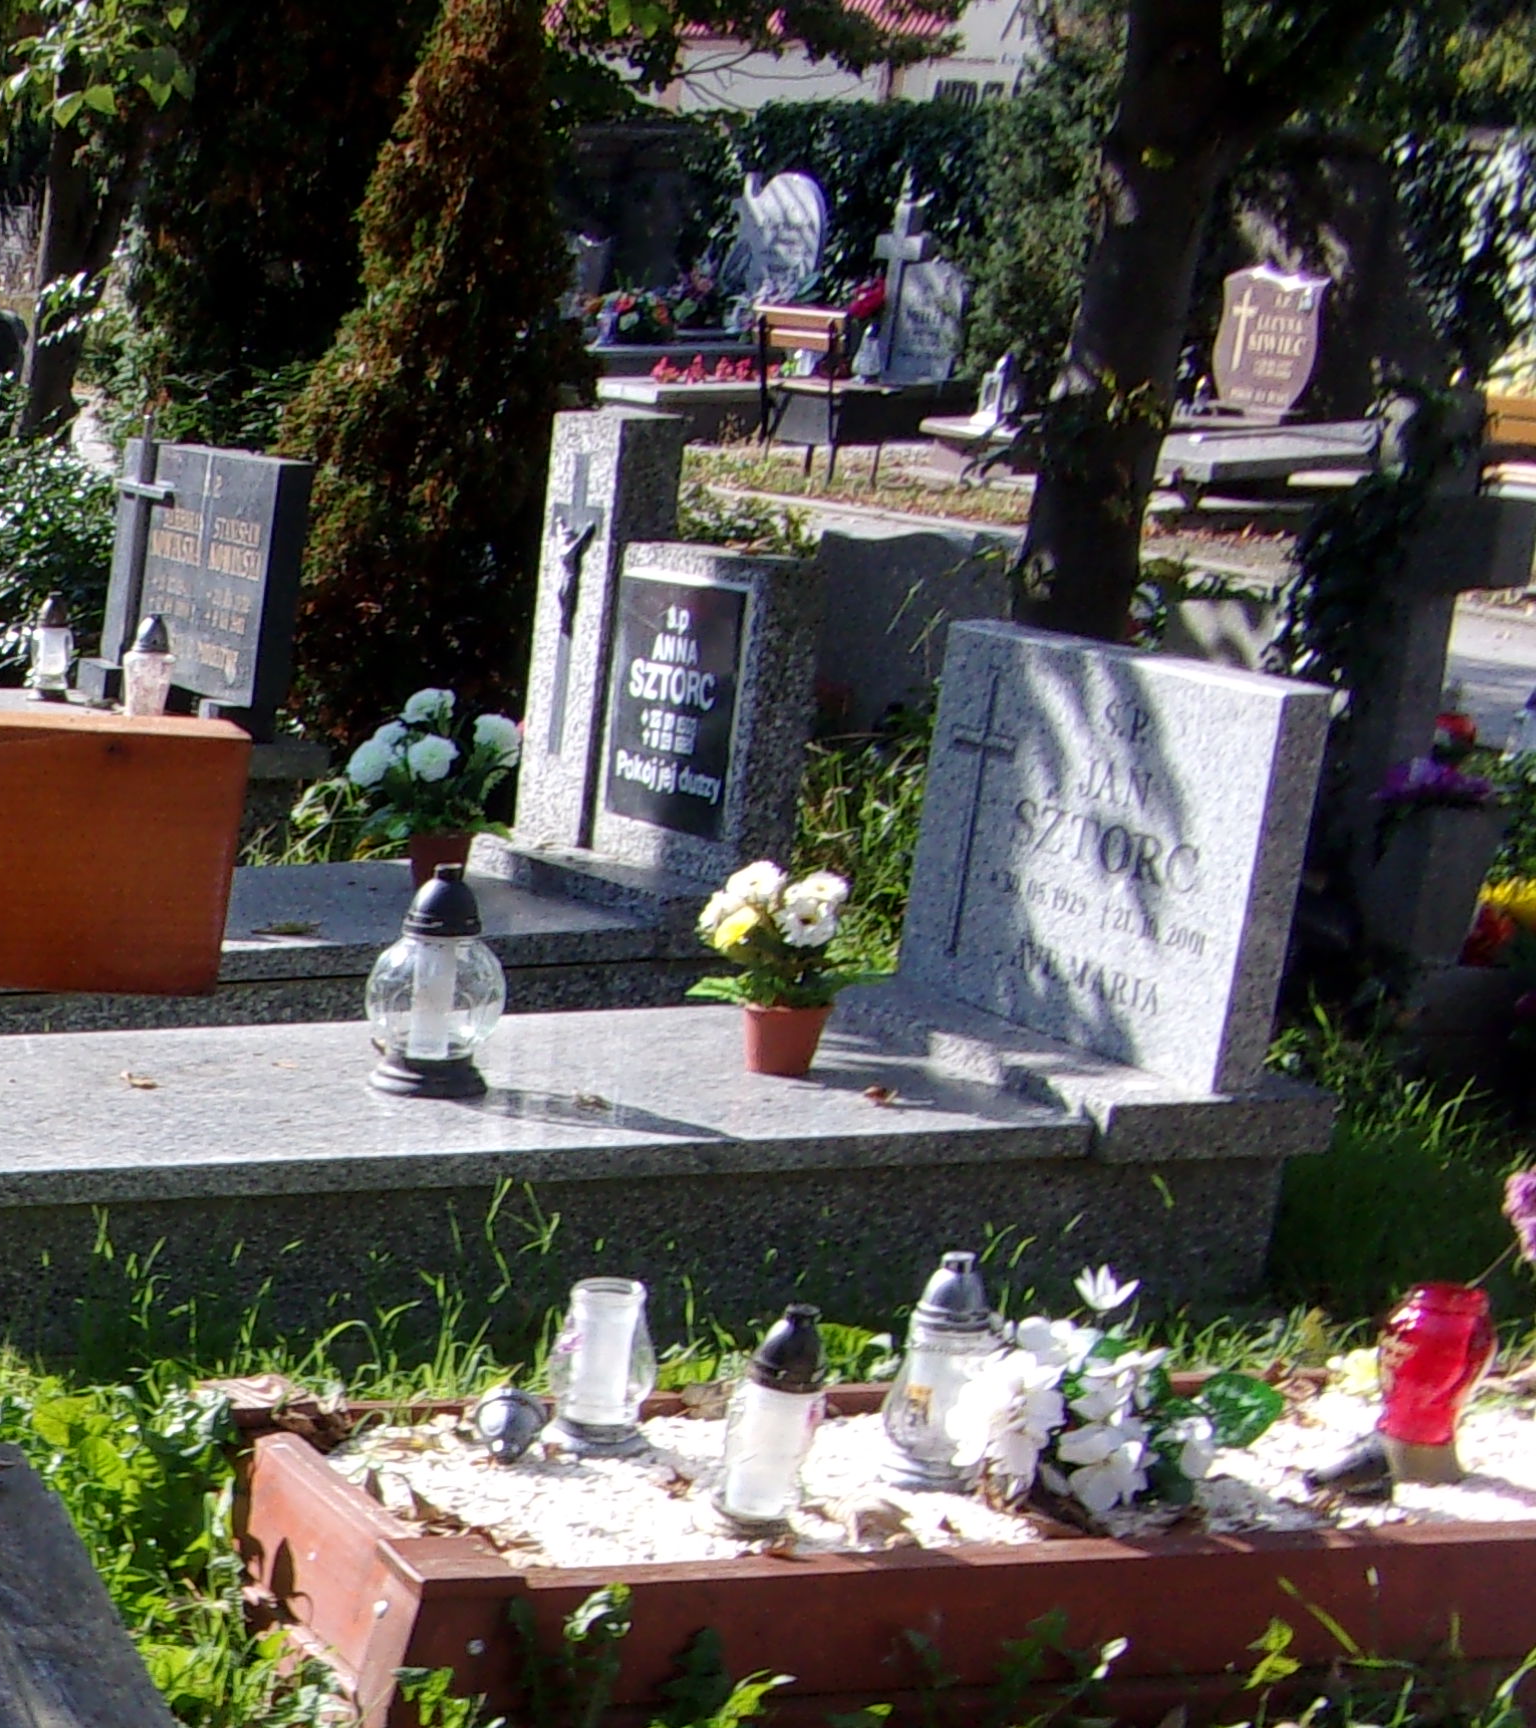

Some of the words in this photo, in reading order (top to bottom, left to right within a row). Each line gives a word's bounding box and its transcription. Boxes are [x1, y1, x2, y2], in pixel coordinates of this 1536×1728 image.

[652, 632, 700, 665] ANNA
[629, 658, 716, 711] SZTORC
[616, 750, 658, 790] Pokój
[1079, 758, 1153, 810] JAN
[1014, 799, 1200, 893] SZTORC
[1070, 956, 1159, 1016] MARIA
